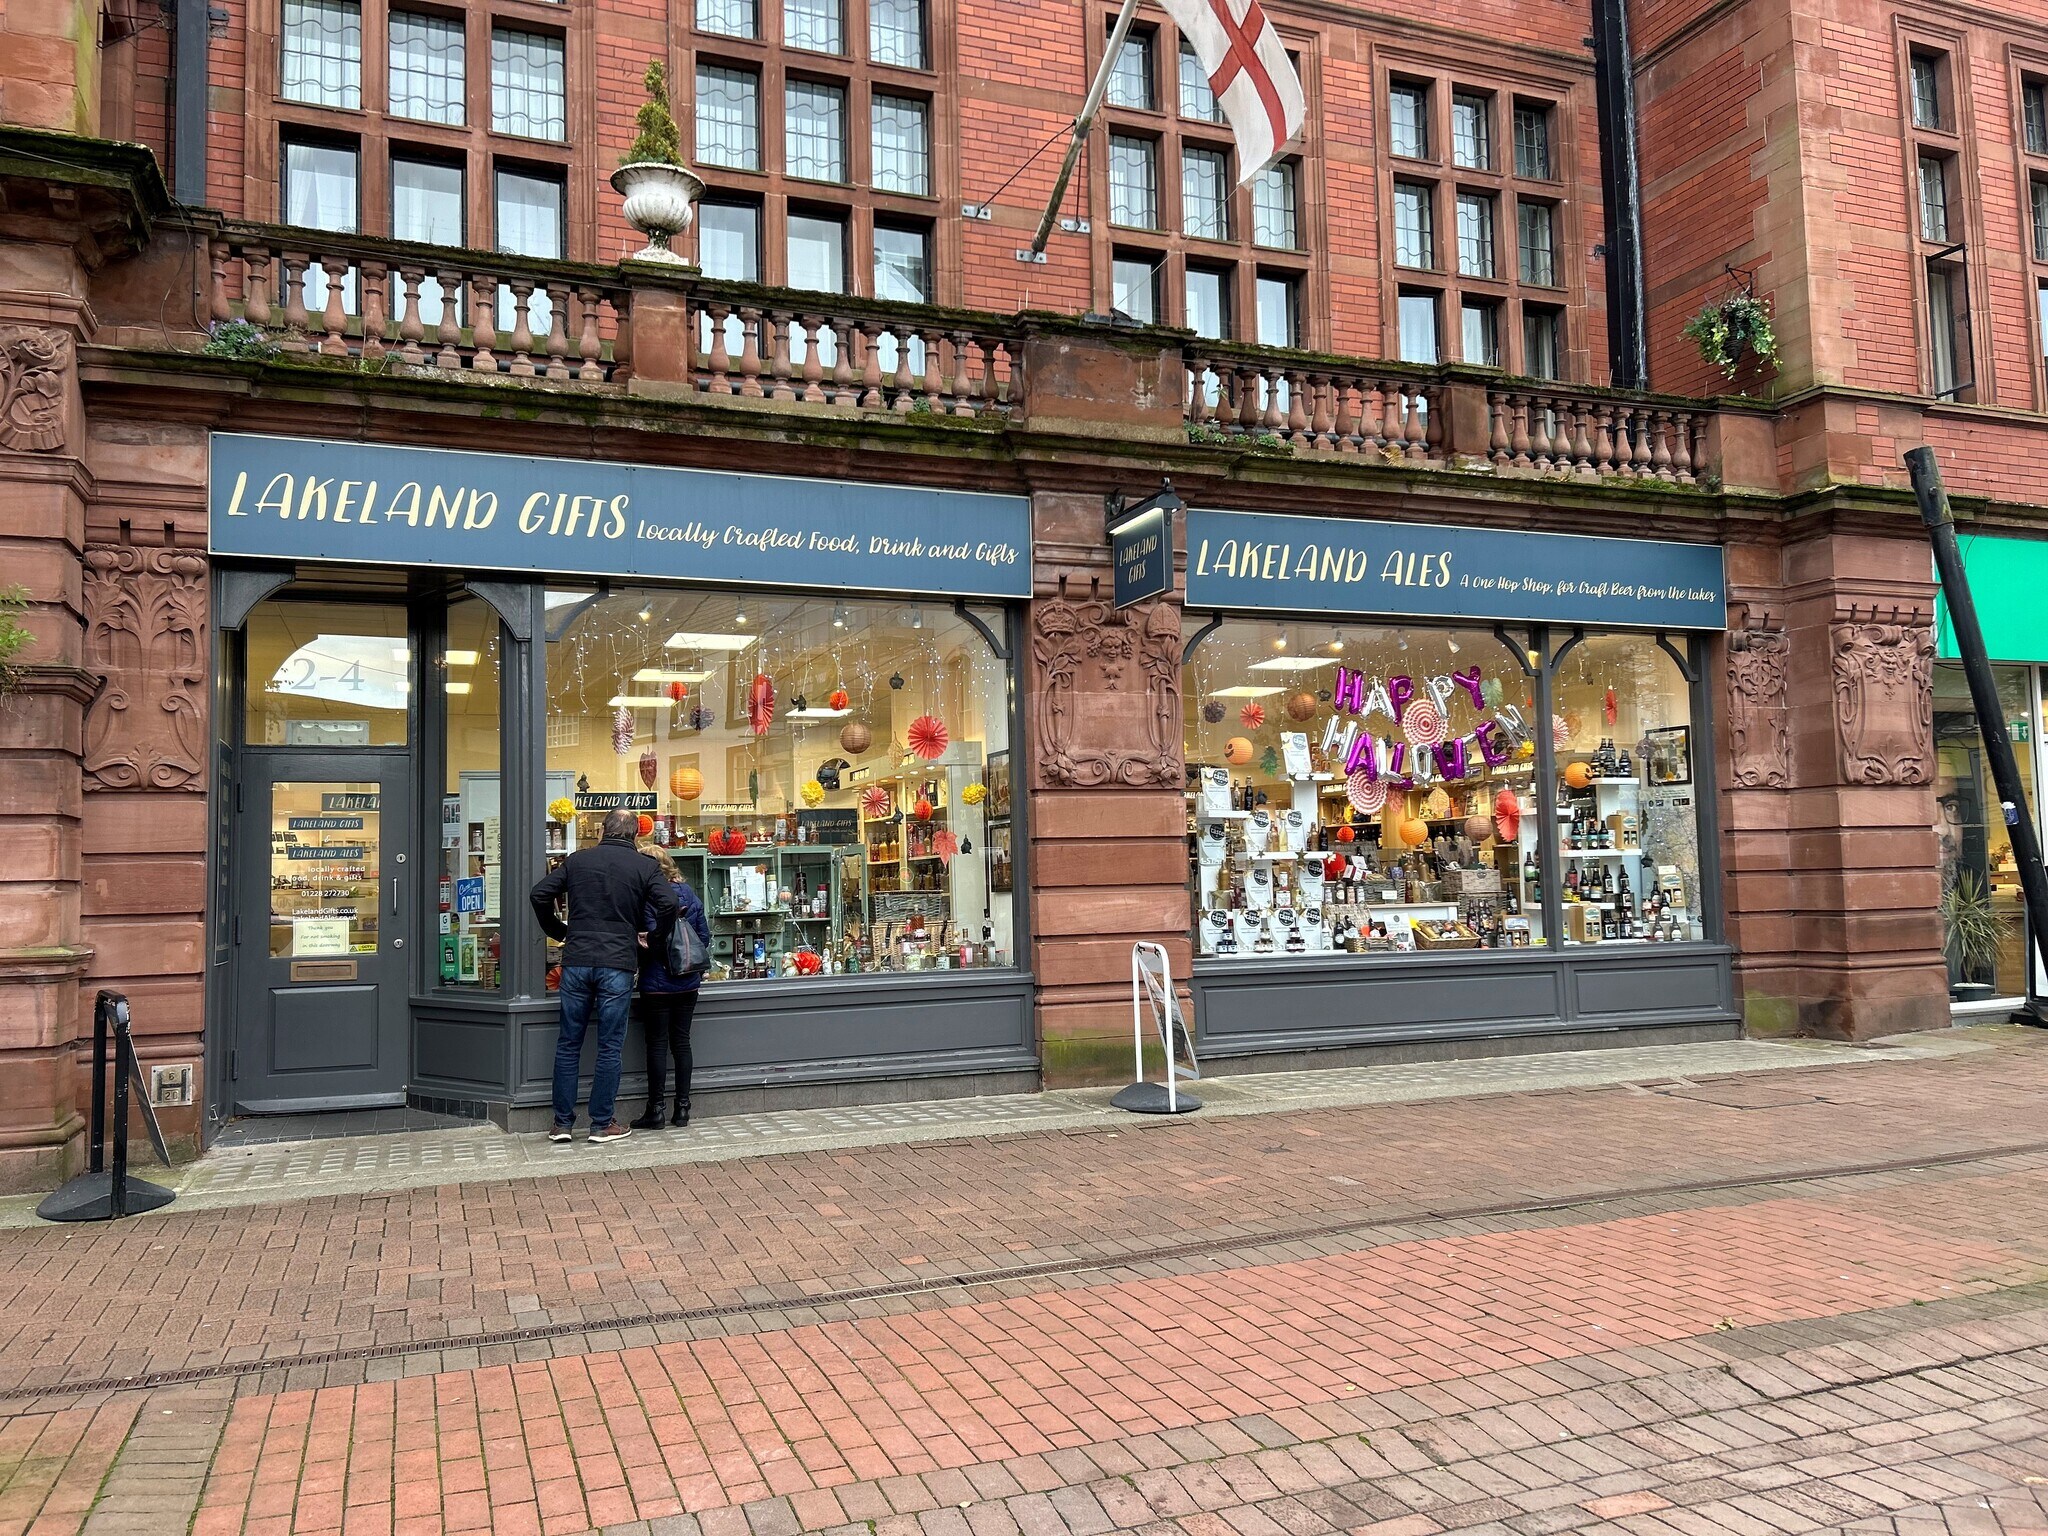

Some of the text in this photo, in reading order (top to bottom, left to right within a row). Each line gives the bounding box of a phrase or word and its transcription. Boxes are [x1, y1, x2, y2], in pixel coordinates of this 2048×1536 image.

[228, 471, 630, 539] LAKELAND GIFTS
[636, 519, 1019, 566] Locally Crafted Food, Drink and Gifts
[1119, 534, 1158, 567] LAKELAND
[1128, 559, 1147, 584] GIFTS
[1196, 539, 1452, 588] LAKELAND ALES
[1460, 574, 1716, 602] A One Hop Shop, for Craft Beer from the Lakes
[291, 658, 365, 691] 2-4
[1335, 665, 1485, 727] HAPPY
[624, 794, 652, 807] GIFTS
[293, 820, 360, 828] LAKELAND GIFTS
[292, 849, 359, 858] LAKELAND ALES
[344, 874, 362, 882] gifts
[462, 895, 480, 911] OPEN
